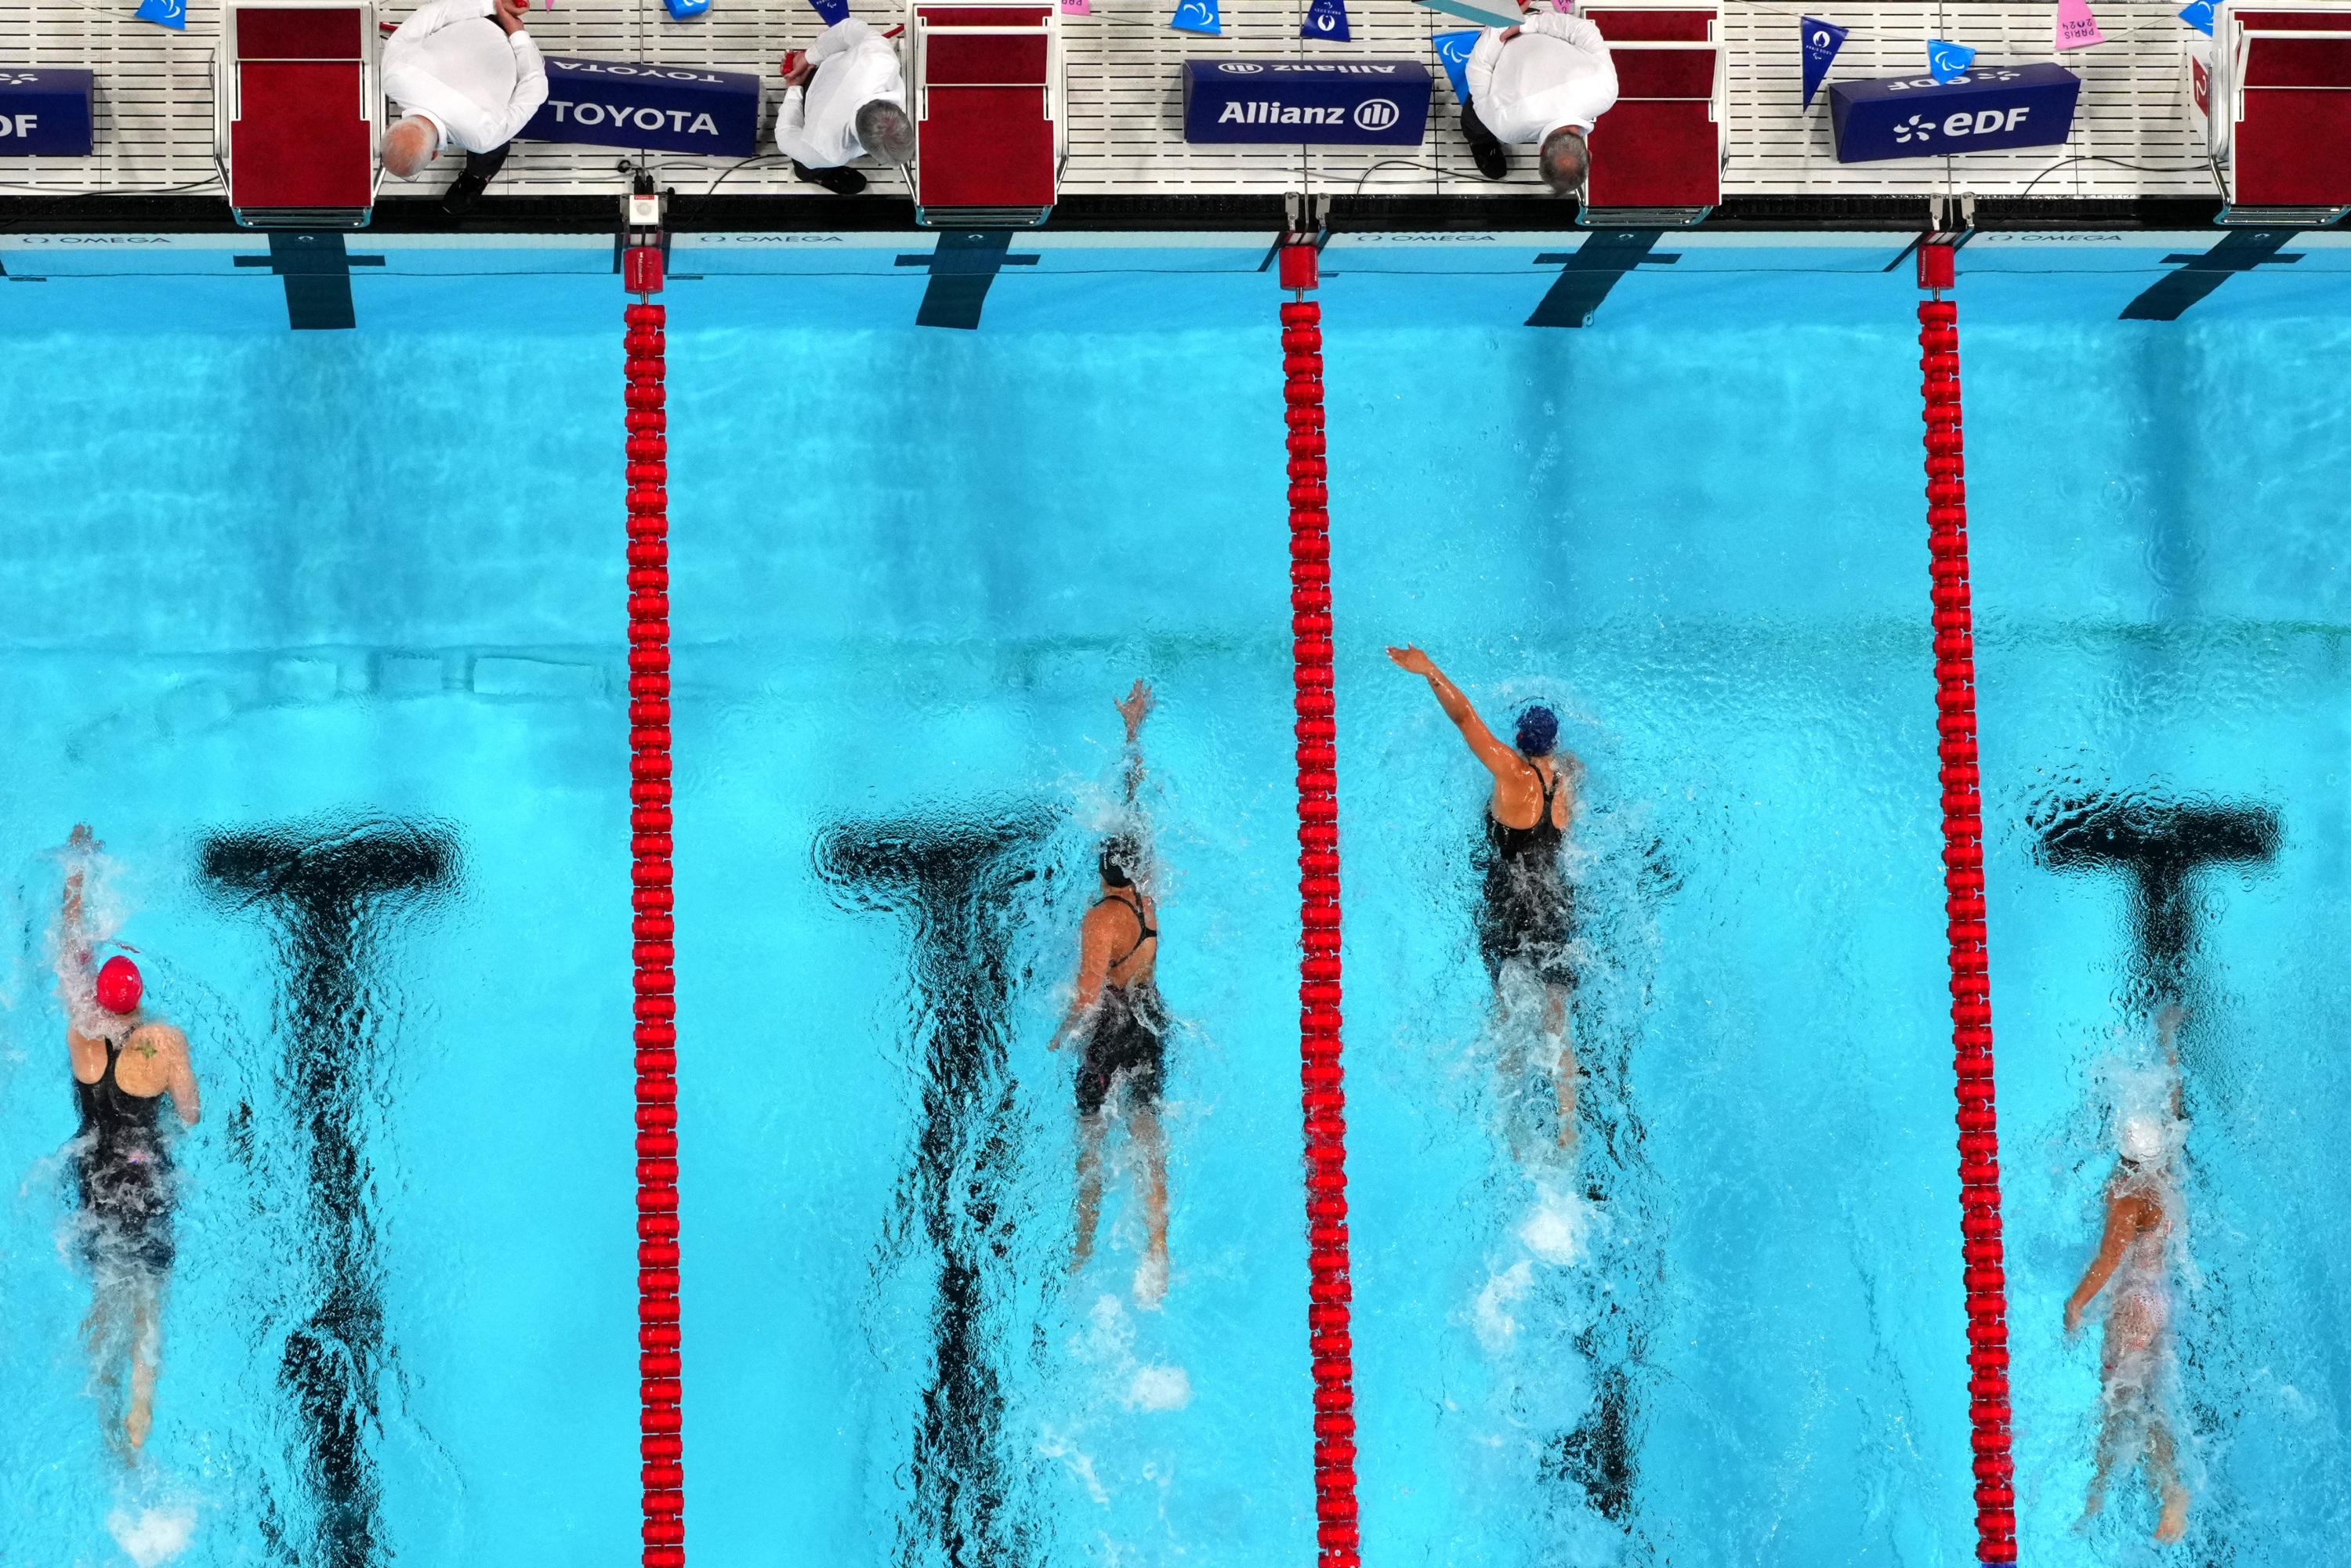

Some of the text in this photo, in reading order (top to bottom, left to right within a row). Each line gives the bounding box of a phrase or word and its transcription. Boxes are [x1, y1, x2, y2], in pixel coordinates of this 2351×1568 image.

[2064, 28, 2094, 39] PARIS
[552, 61, 724, 83] TOYOTA
[1271, 64, 1396, 74] Allianz
[2196, 74, 2207, 101] 2
[548, 100, 719, 136] TOYOTA
[1218, 102, 1346, 125] Allianz
[1943, 107, 2030, 137] eDF
